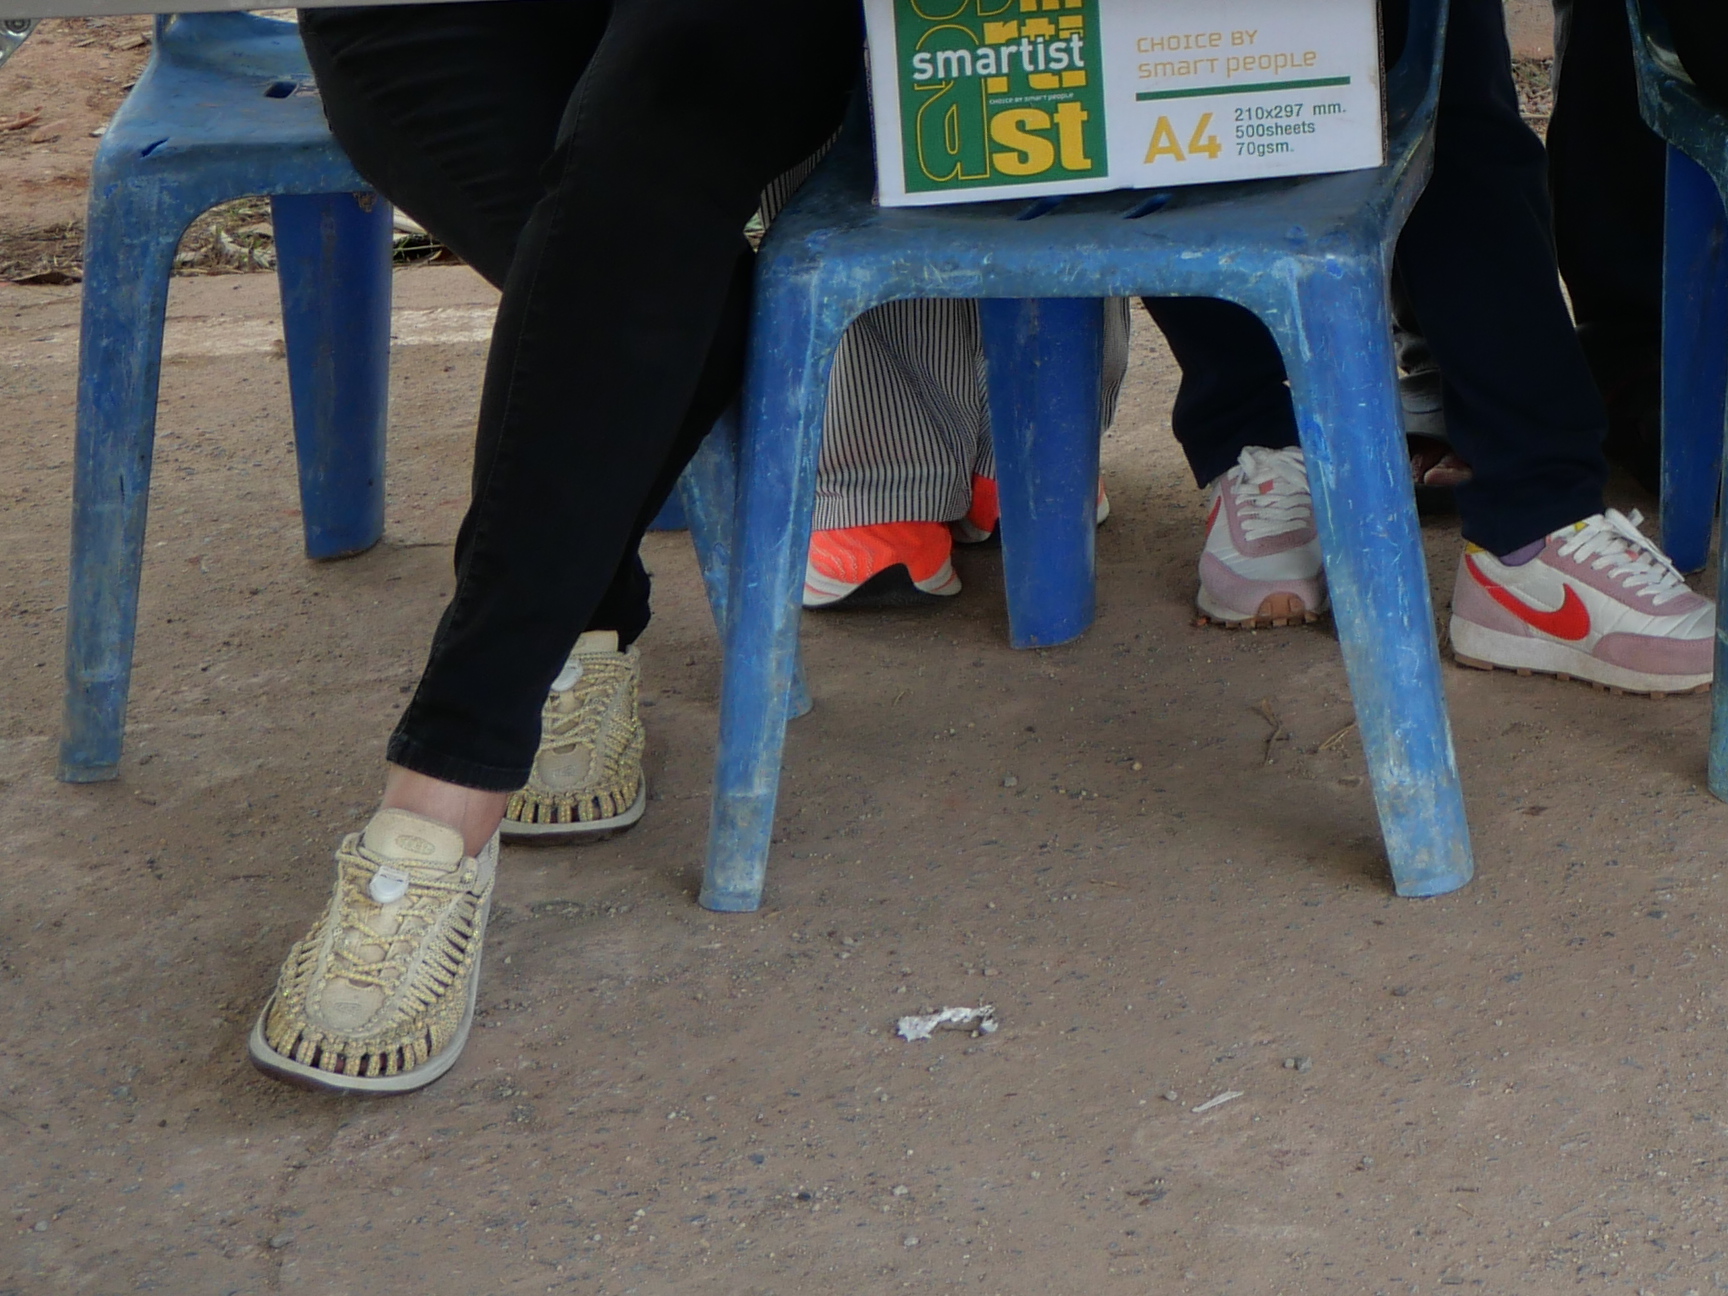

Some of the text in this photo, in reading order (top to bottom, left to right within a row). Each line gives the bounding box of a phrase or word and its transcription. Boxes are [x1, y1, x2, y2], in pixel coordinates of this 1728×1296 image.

[1230, 29, 1258, 47] BY
[912, 33, 1086, 81] smartist
[1142, 102, 1348, 165] A4 210x297 mm.
[1234, 120, 1316, 139] 500sheets
[1235, 140, 1295, 157] 70gsm.
